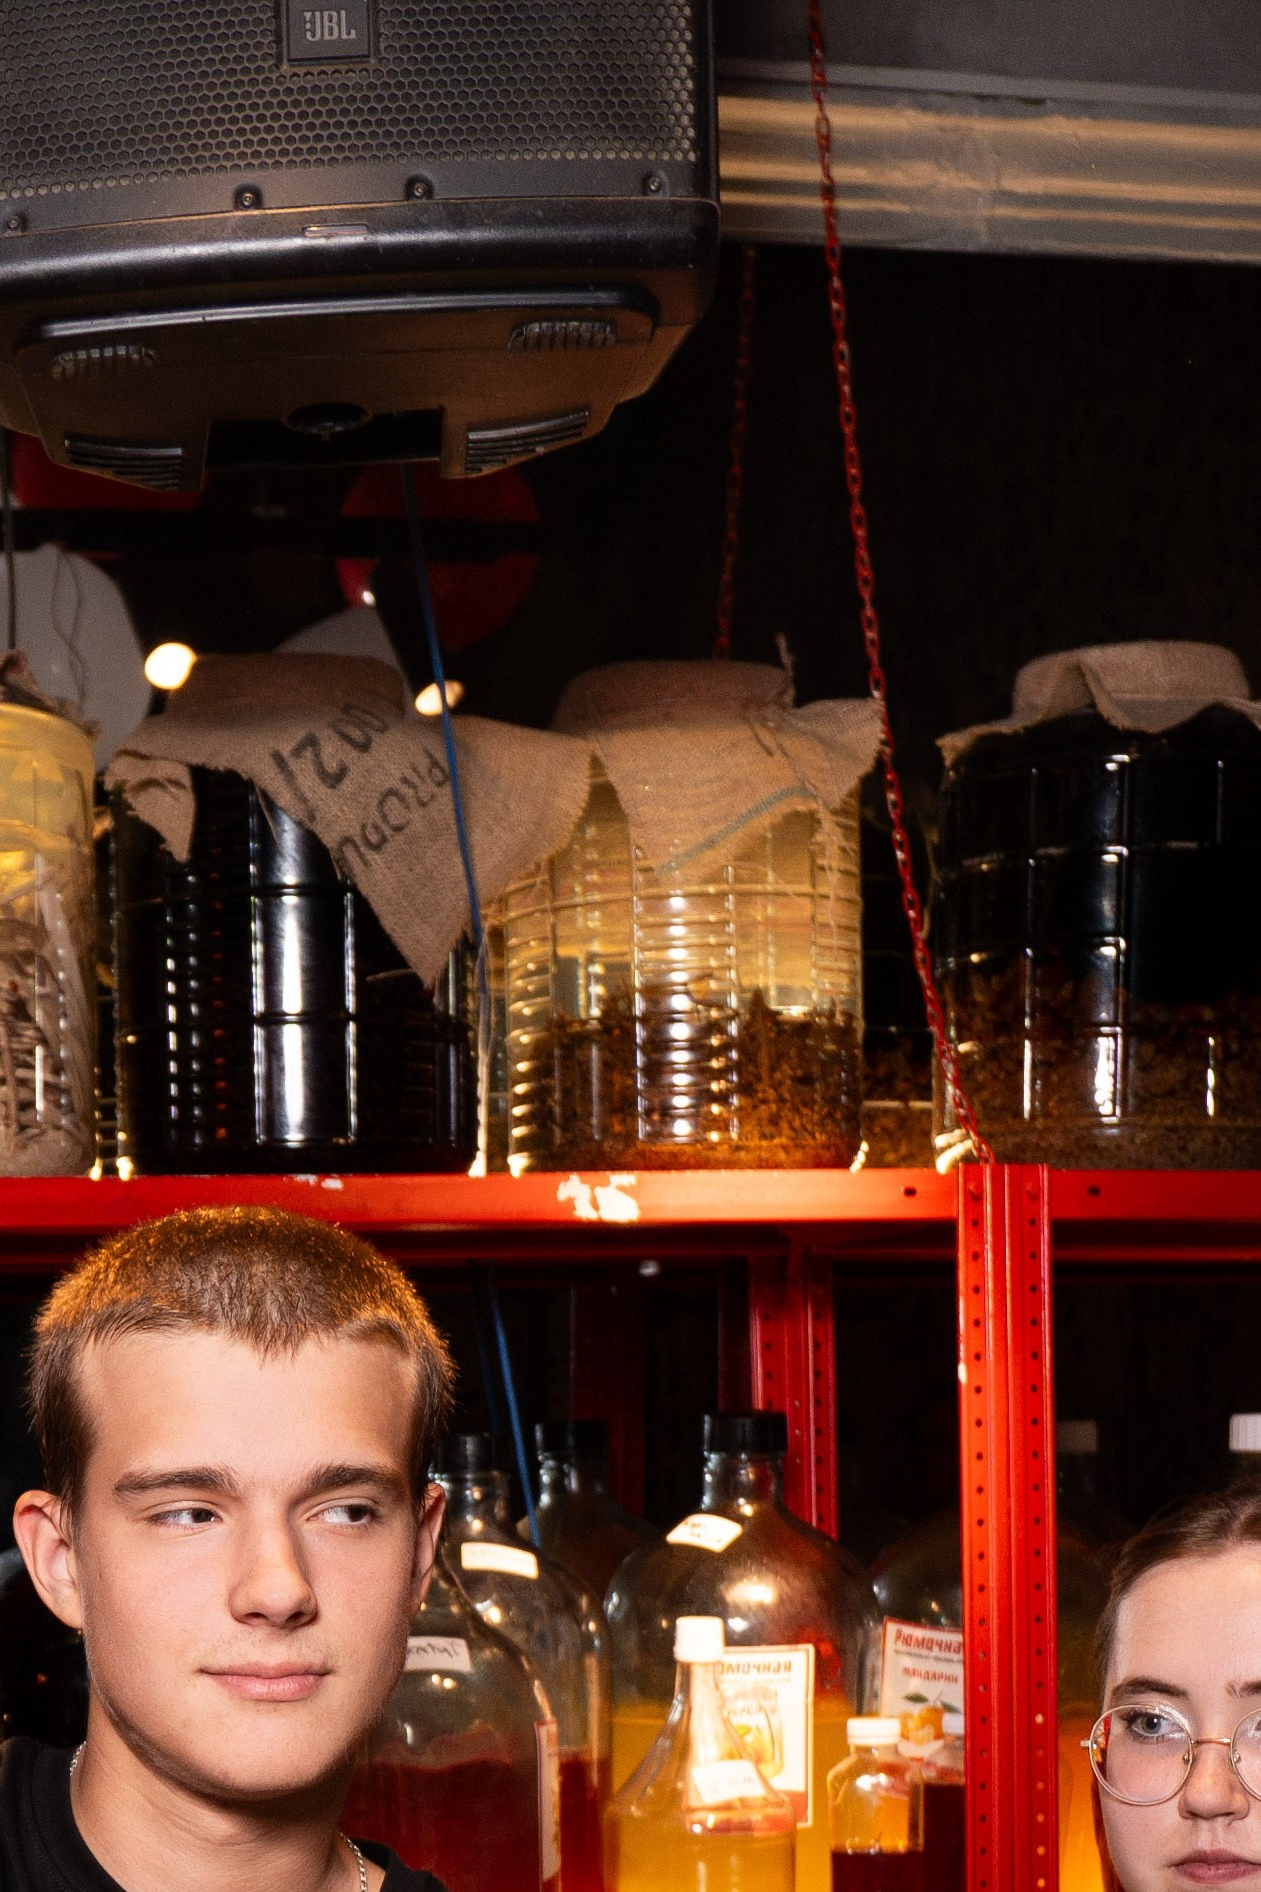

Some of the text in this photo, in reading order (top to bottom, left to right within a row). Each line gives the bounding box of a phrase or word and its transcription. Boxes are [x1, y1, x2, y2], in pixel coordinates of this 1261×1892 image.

[303, 9, 356, 41] JBL
[338, 745, 452, 873] PRODU
[895, 1629, 963, 1654] Рюмочна
